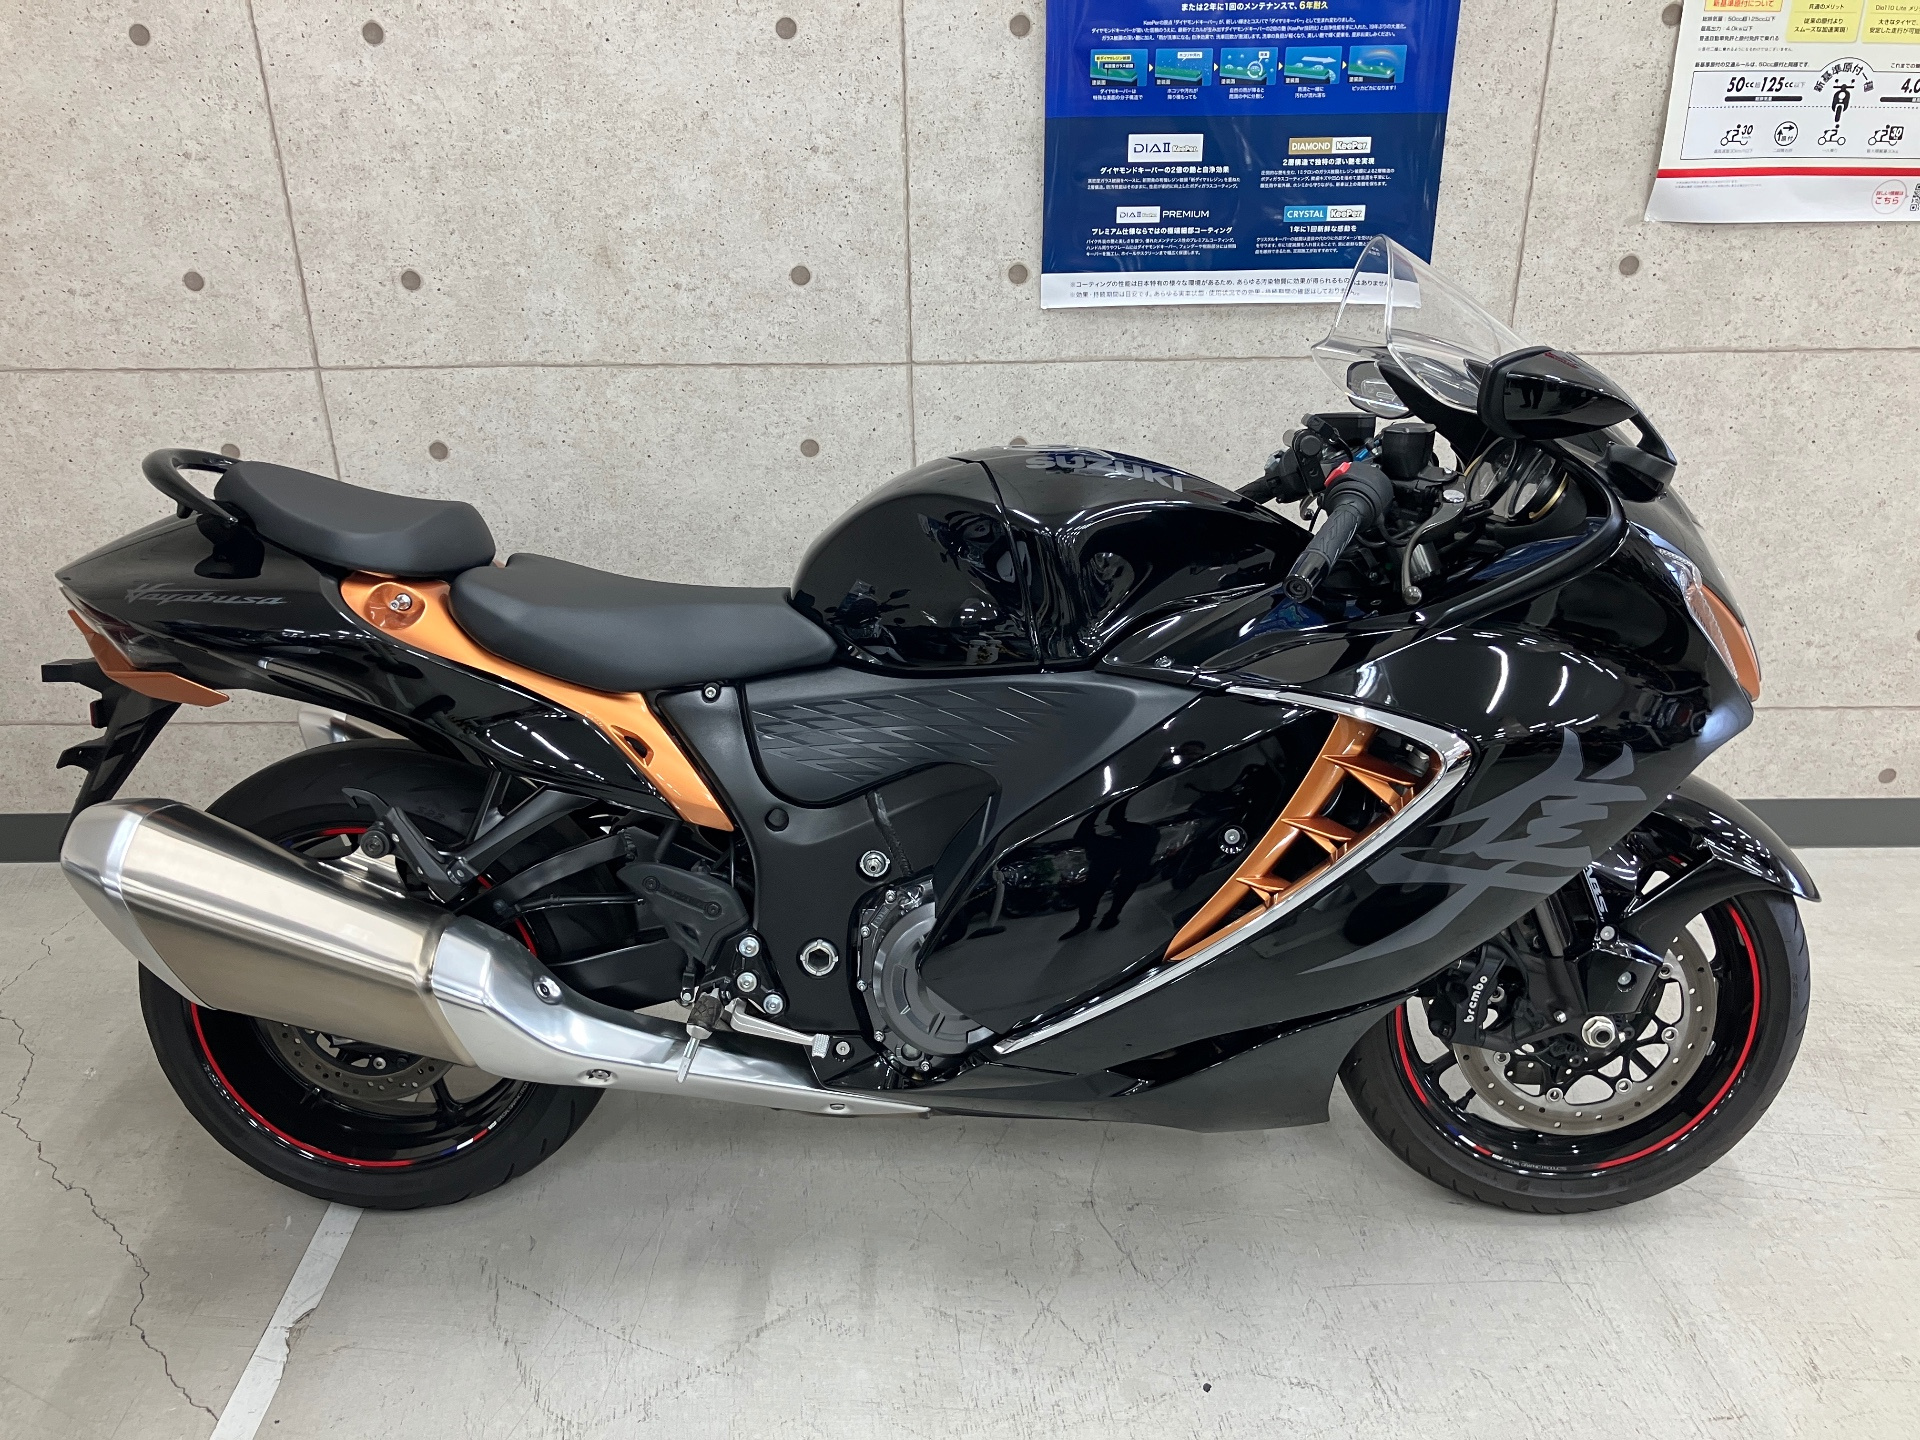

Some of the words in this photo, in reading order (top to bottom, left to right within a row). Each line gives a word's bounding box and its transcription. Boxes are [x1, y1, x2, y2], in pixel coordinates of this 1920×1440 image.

[1741, 124, 1754, 135] 30
[1890, 127, 1903, 137] 30
[1291, 142, 1331, 151] DIAMOND
[1874, 197, 1900, 205] こちら
[1162, 210, 1210, 218] PREMIUM
[1286, 210, 1324, 218] CRYSTAL
[1025, 455, 1184, 493] SUZUKI
[124, 582, 290, 606] Hayabusa
[1463, 975, 1488, 1023] brembo
